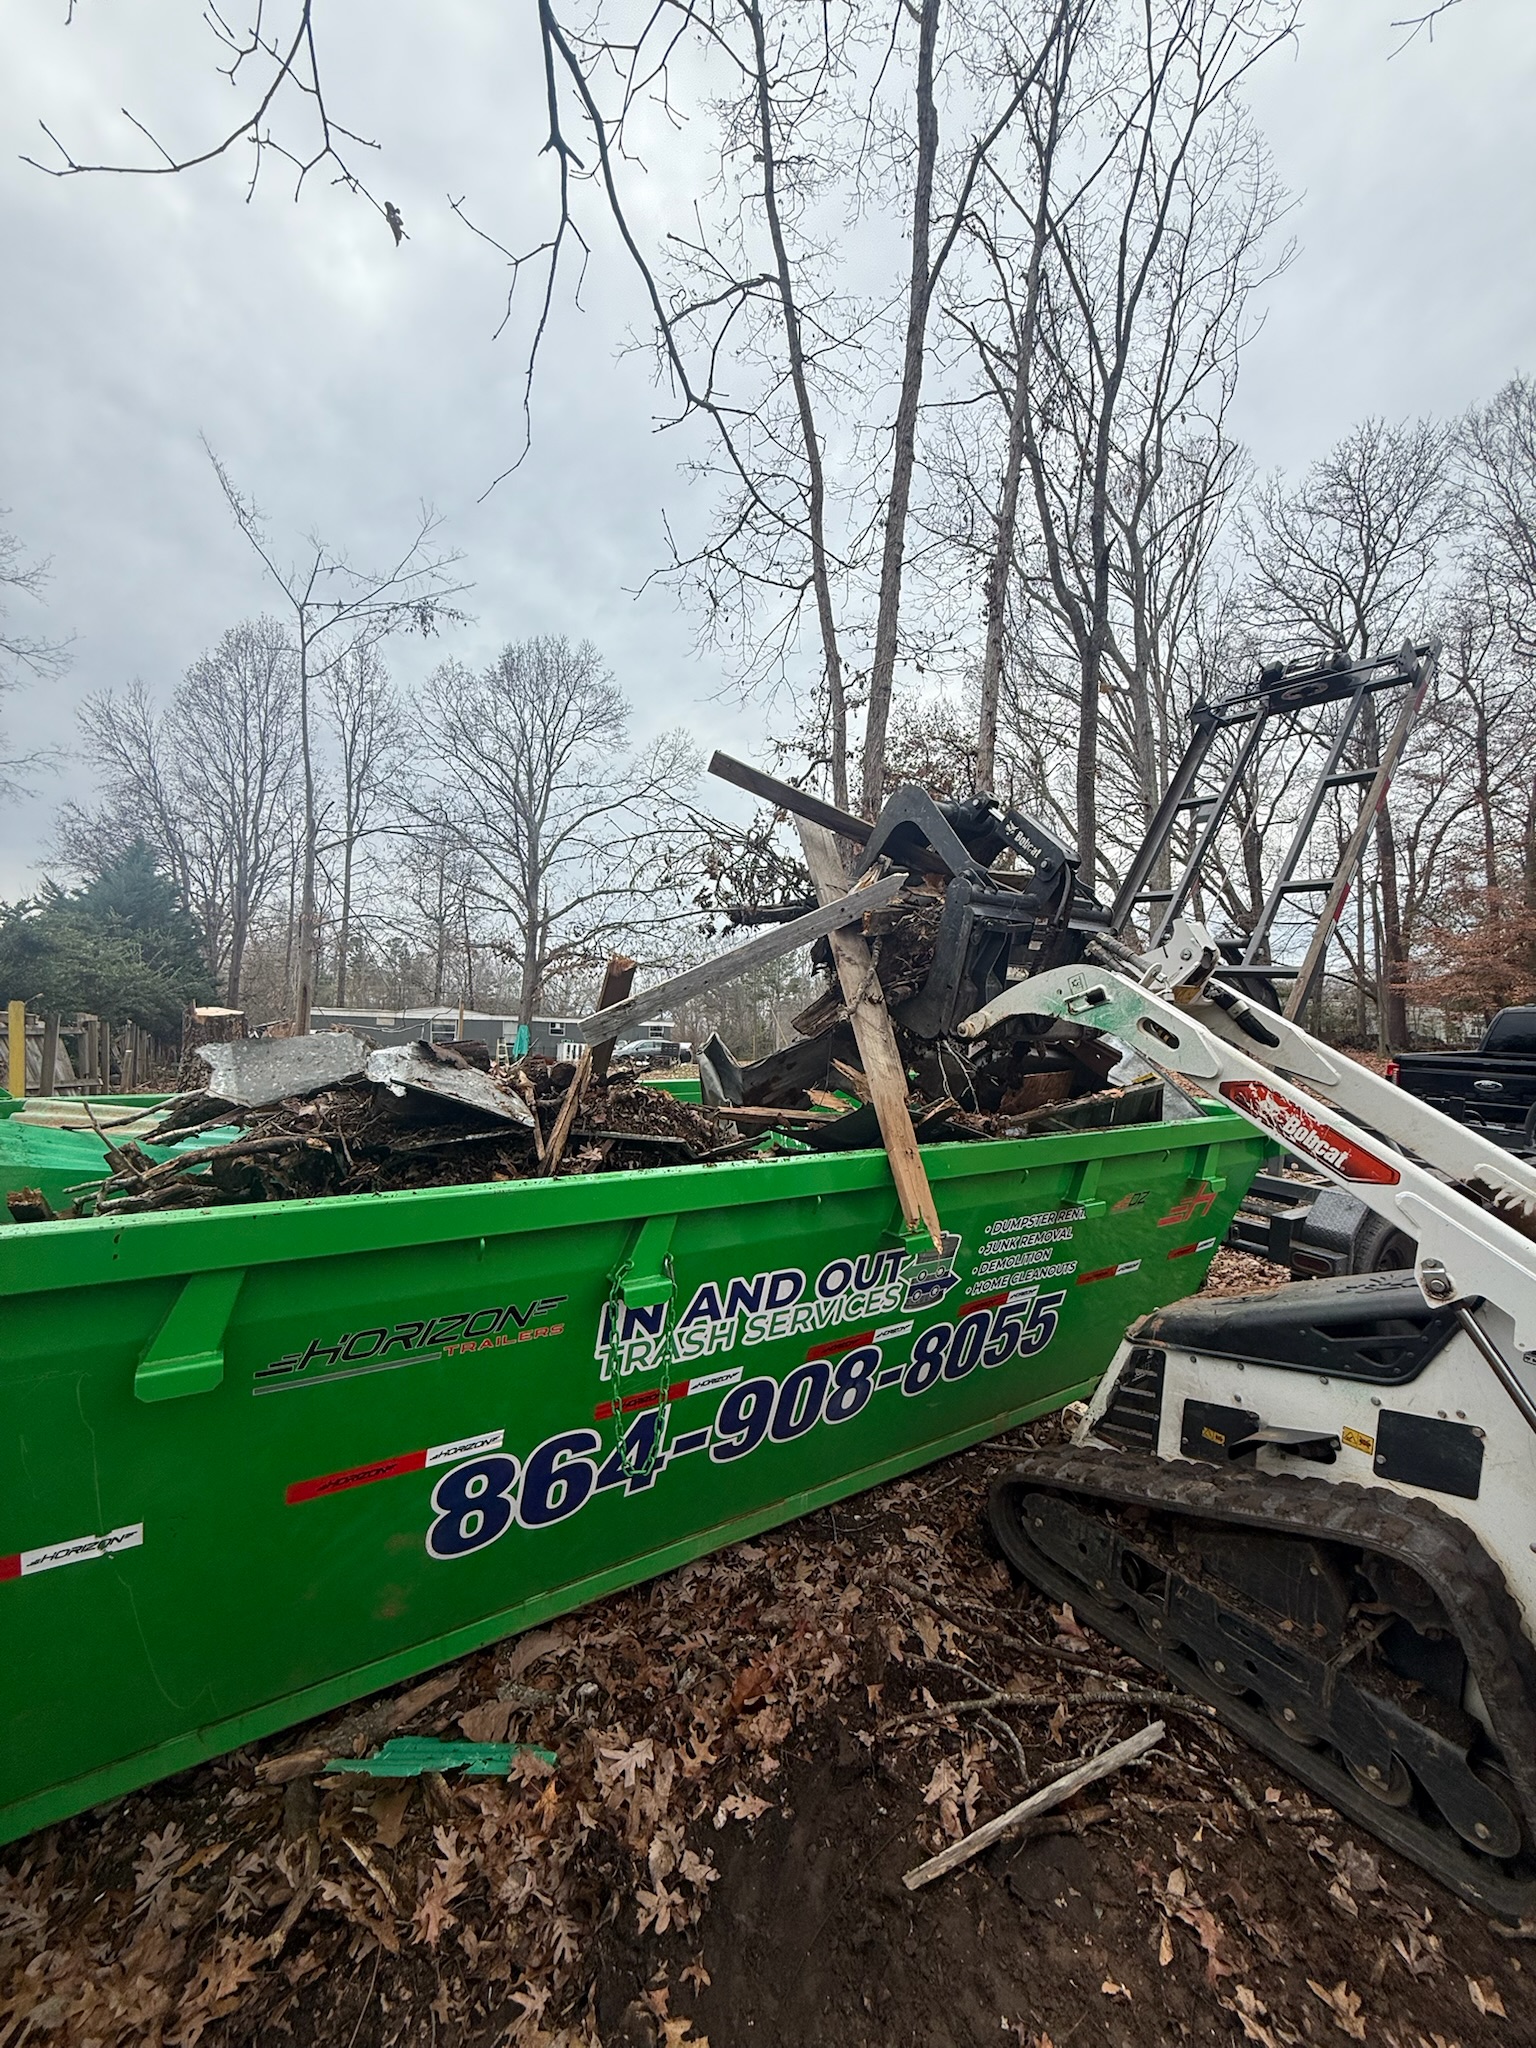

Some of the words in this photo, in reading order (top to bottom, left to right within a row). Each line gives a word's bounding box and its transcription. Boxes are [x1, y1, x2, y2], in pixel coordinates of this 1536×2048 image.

[1014, 831, 1042, 858] Bobcat
[1283, 1116, 1350, 1171] Bobcat
[991, 1211, 1057, 1236] DUMPSTER
[984, 1236, 1020, 1256] JUNK
[1019, 1226, 1073, 1250] REMOVAL
[971, 1273, 1009, 1296] HOME
[1009, 1260, 1078, 1285] CLEANOUTS
[978, 1248, 1053, 1276] DEMOLITION
[677, 1268, 807, 1330] AND
[815, 1249, 908, 1301] OUT
[288, 1297, 552, 1372] HORIZON
[443, 1323, 565, 1357] TRAILERS
[595, 1318, 736, 1381] TRASH
[743, 1282, 903, 1348] SERVICES
[690, 1371, 740, 1391] HORIZON
[425, 1290, 1067, 1560] 864-908-8055
[430, 1436, 500, 1461] HORIZON
[33, 1532, 134, 1564] HORIZON
